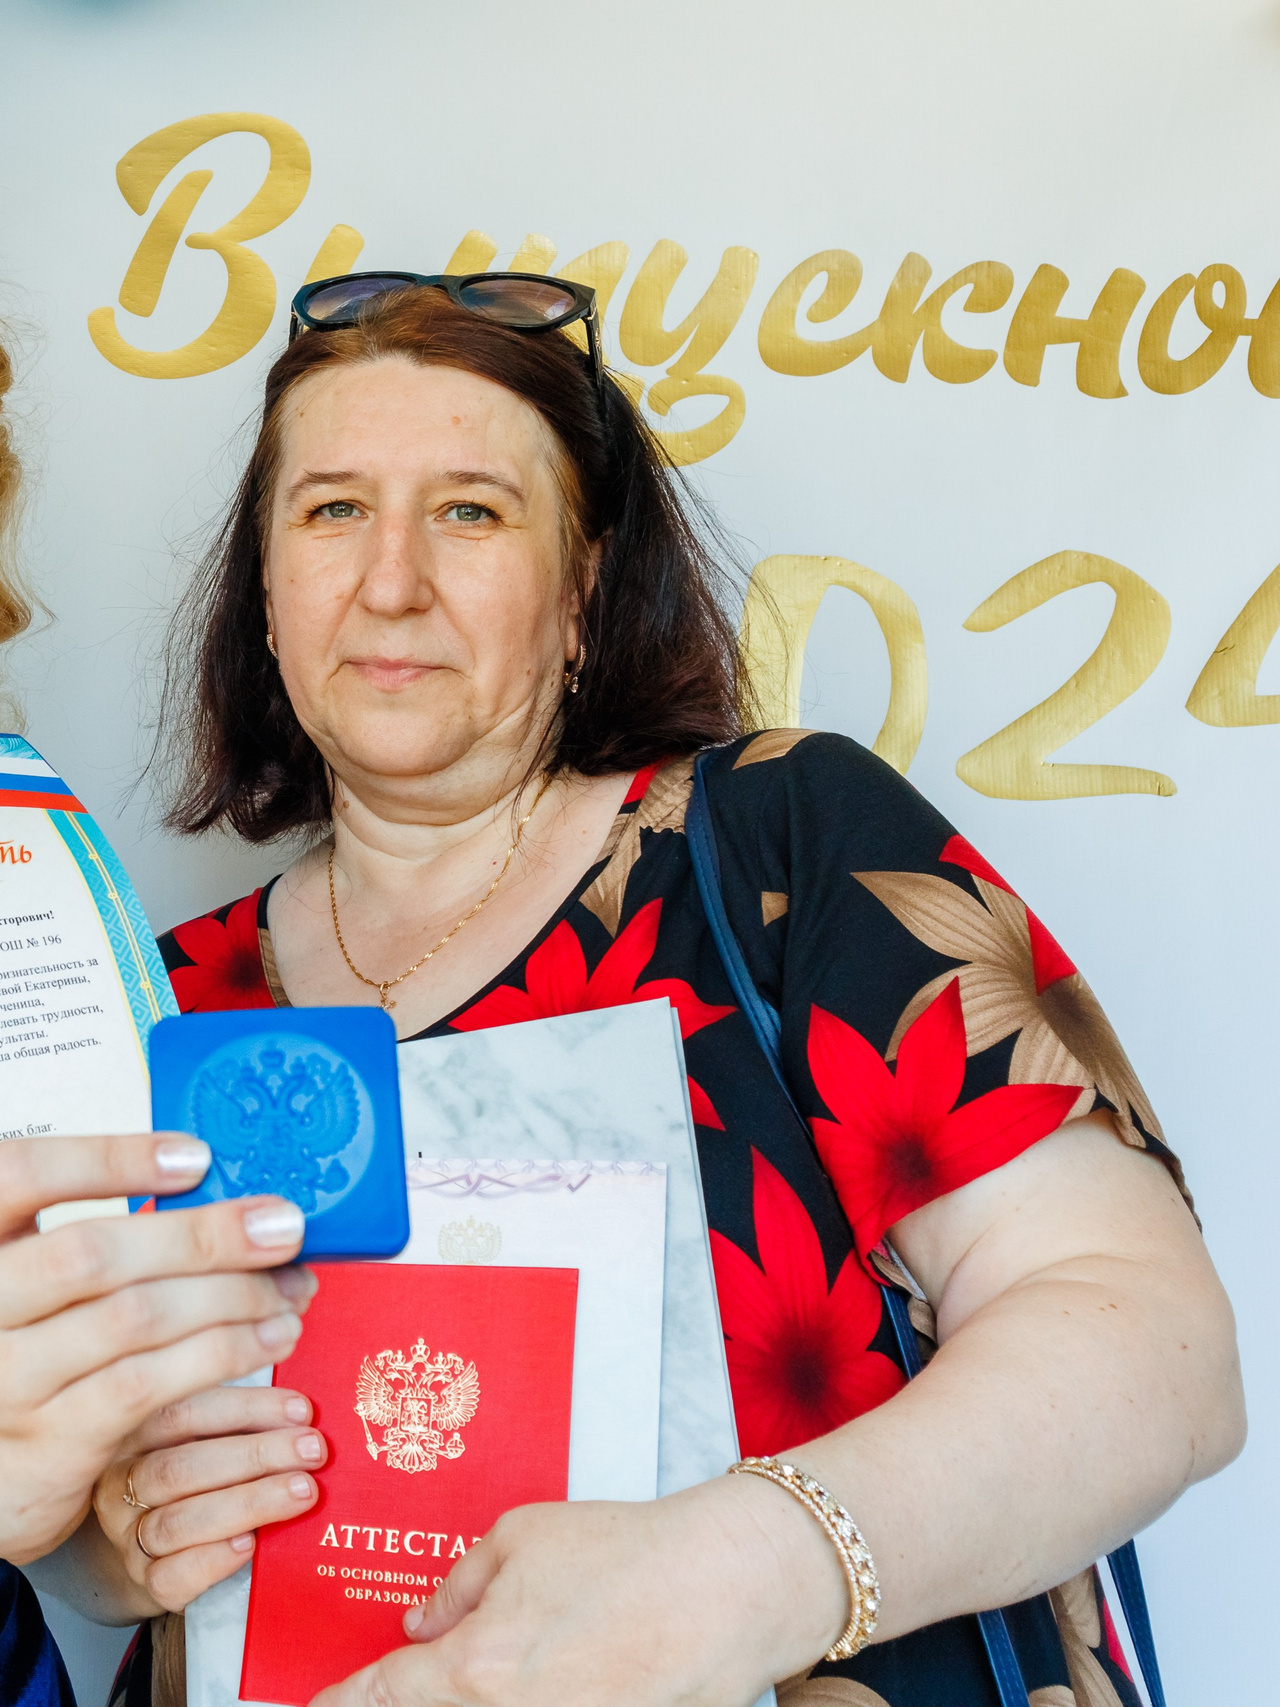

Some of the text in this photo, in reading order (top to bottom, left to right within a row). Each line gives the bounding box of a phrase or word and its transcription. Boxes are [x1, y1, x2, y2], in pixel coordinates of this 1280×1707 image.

[87, 112, 1280, 466] Вускно
[26, 937, 39, 948] №
[43, 934, 62, 946] 196
[86, 958, 99, 967] за
[24, 974, 91, 992] Екатерины,
[40, 1003, 104, 1024] трудности,
[14, 1046, 50, 1061] общая
[54, 1036, 102, 1056] радость.
[27, 1123, 57, 1136] благ.
[319, 1523, 483, 1559] АТТЕСТА
[317, 1565, 336, 1577] ОБ
[341, 1567, 428, 1587] ОСНОВНОМ
